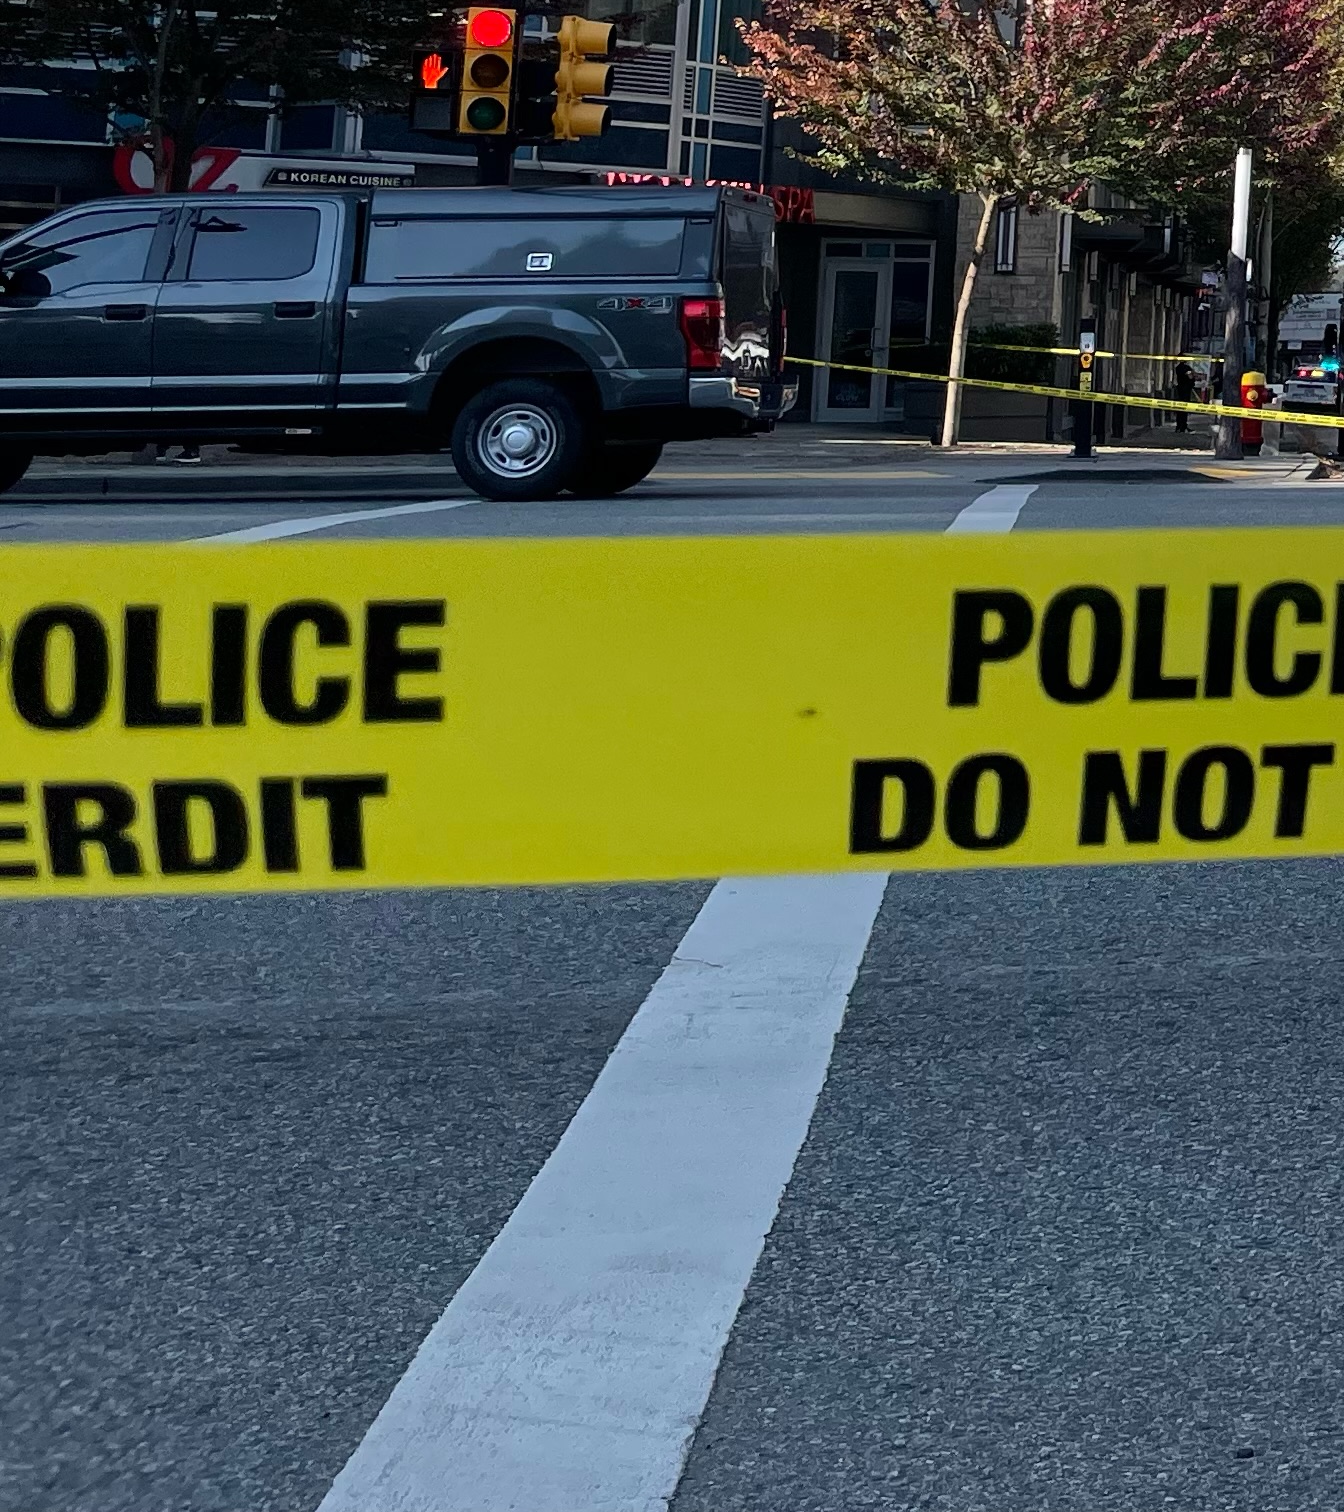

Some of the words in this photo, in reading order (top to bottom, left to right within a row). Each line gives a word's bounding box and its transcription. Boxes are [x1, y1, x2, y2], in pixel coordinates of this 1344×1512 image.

[290, 172, 347, 185] KOREAN
[350, 174, 402, 187] CUISINE
[0, 598, 448, 733] OLICE
[848, 750, 1033, 856] DO
[1078, 741, 1337, 847] NOT
